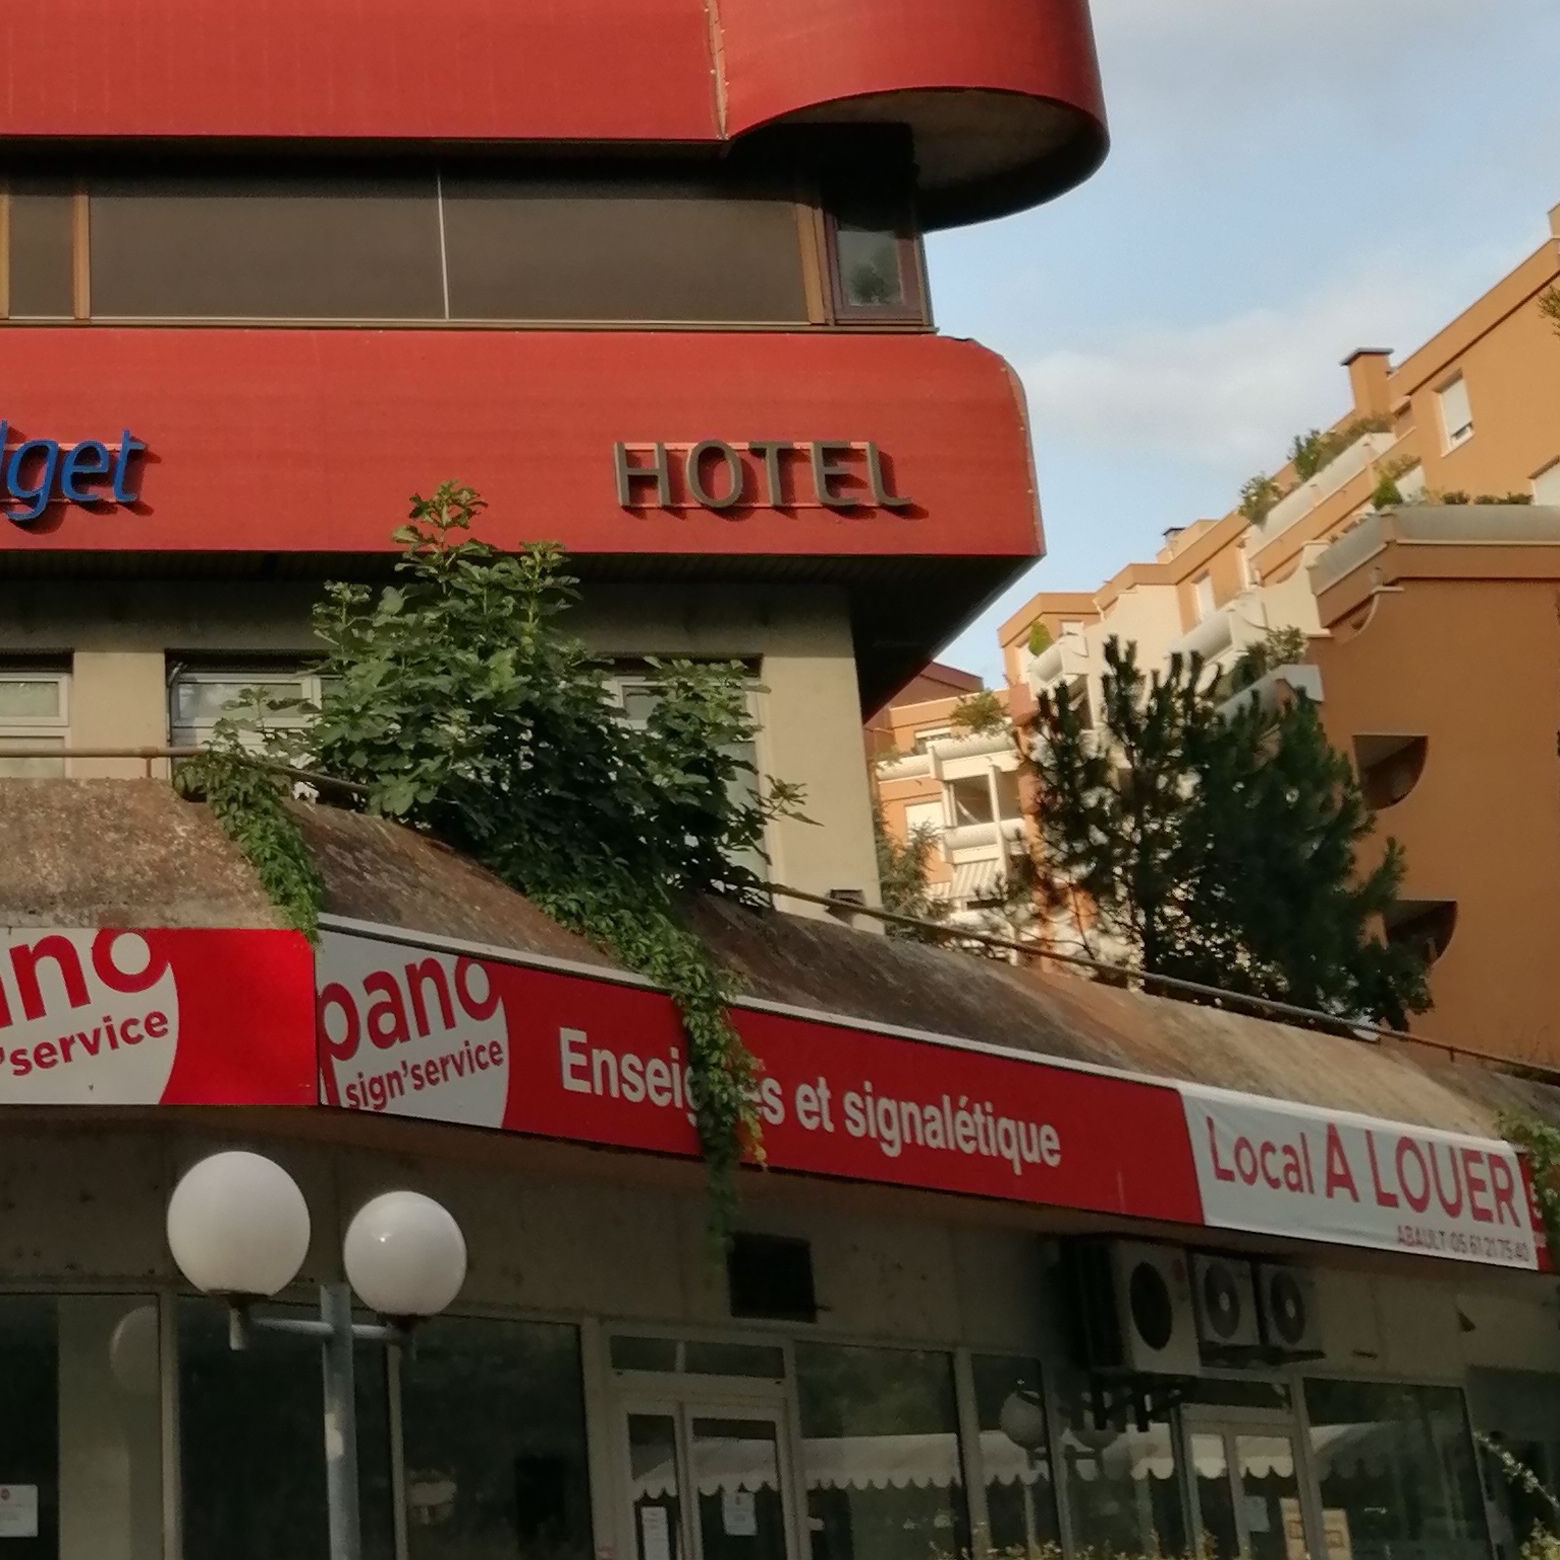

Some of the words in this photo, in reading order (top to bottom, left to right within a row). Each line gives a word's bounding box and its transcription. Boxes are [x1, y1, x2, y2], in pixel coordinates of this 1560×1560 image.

[613, 439, 912, 509] HOTEL
[317, 956, 502, 1106] pano
[345, 1040, 504, 1111] sign'service
[559, 1027, 785, 1128] Enseis
[795, 1076, 834, 1133] et
[844, 1081, 1061, 1175] signalétique
[1206, 1116, 1315, 1194] Local
[1325, 1122, 1360, 1203] A
[1364, 1129, 1521, 1228] LOUER
